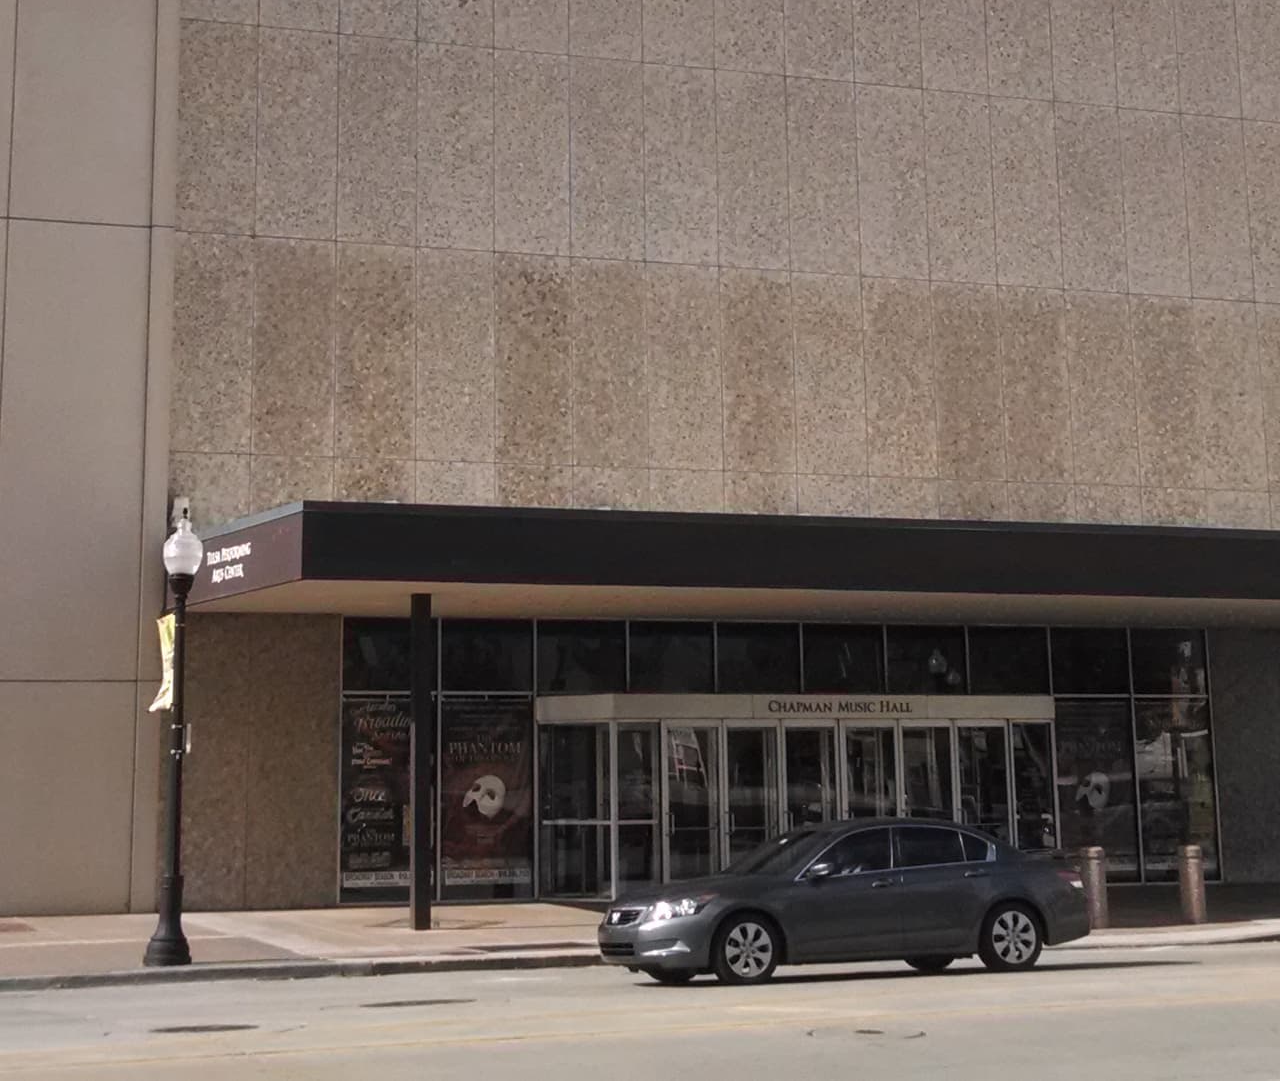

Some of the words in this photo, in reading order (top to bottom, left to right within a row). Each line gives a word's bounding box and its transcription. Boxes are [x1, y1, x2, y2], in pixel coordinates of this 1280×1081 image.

[767, 699, 833, 714] CHAPMAN
[837, 700, 876, 713] MUSIC
[879, 700, 913, 714] HALL
